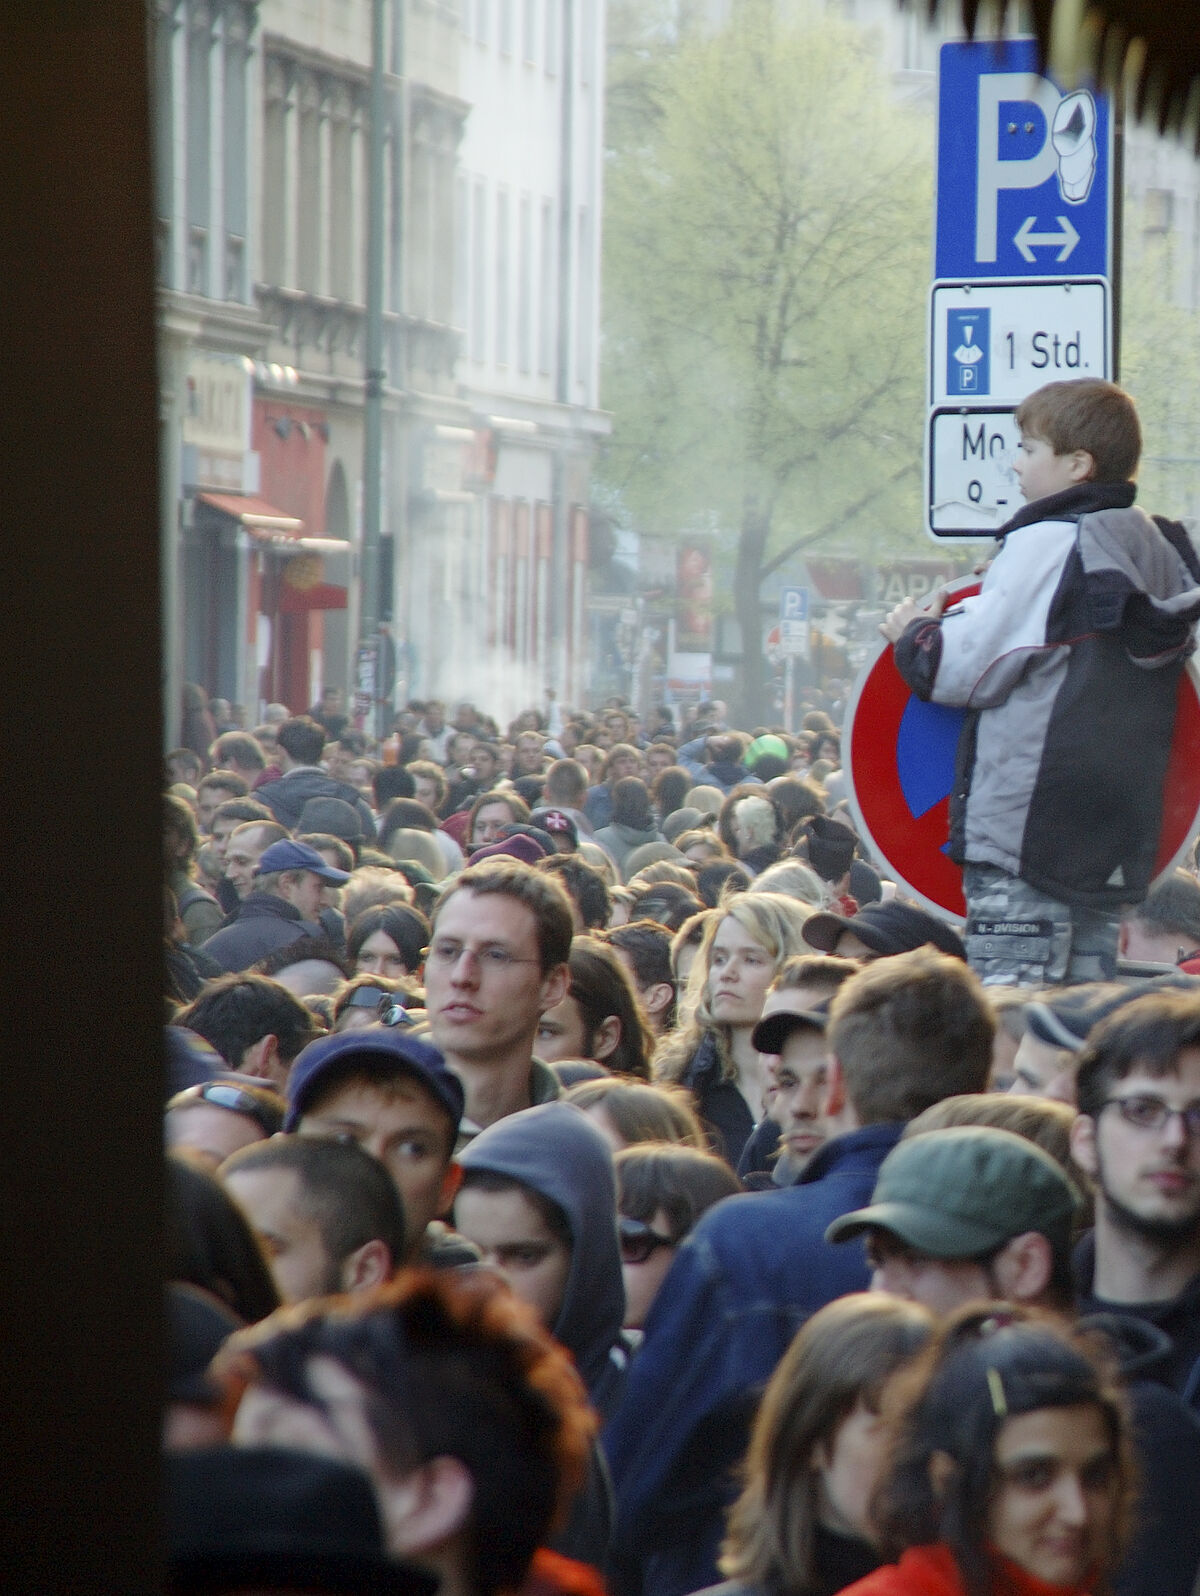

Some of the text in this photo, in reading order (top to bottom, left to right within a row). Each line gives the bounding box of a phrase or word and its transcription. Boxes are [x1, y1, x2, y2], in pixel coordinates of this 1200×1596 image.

[975, 72, 1064, 263] P
[1006, 330, 1090, 370] 1 Std.
